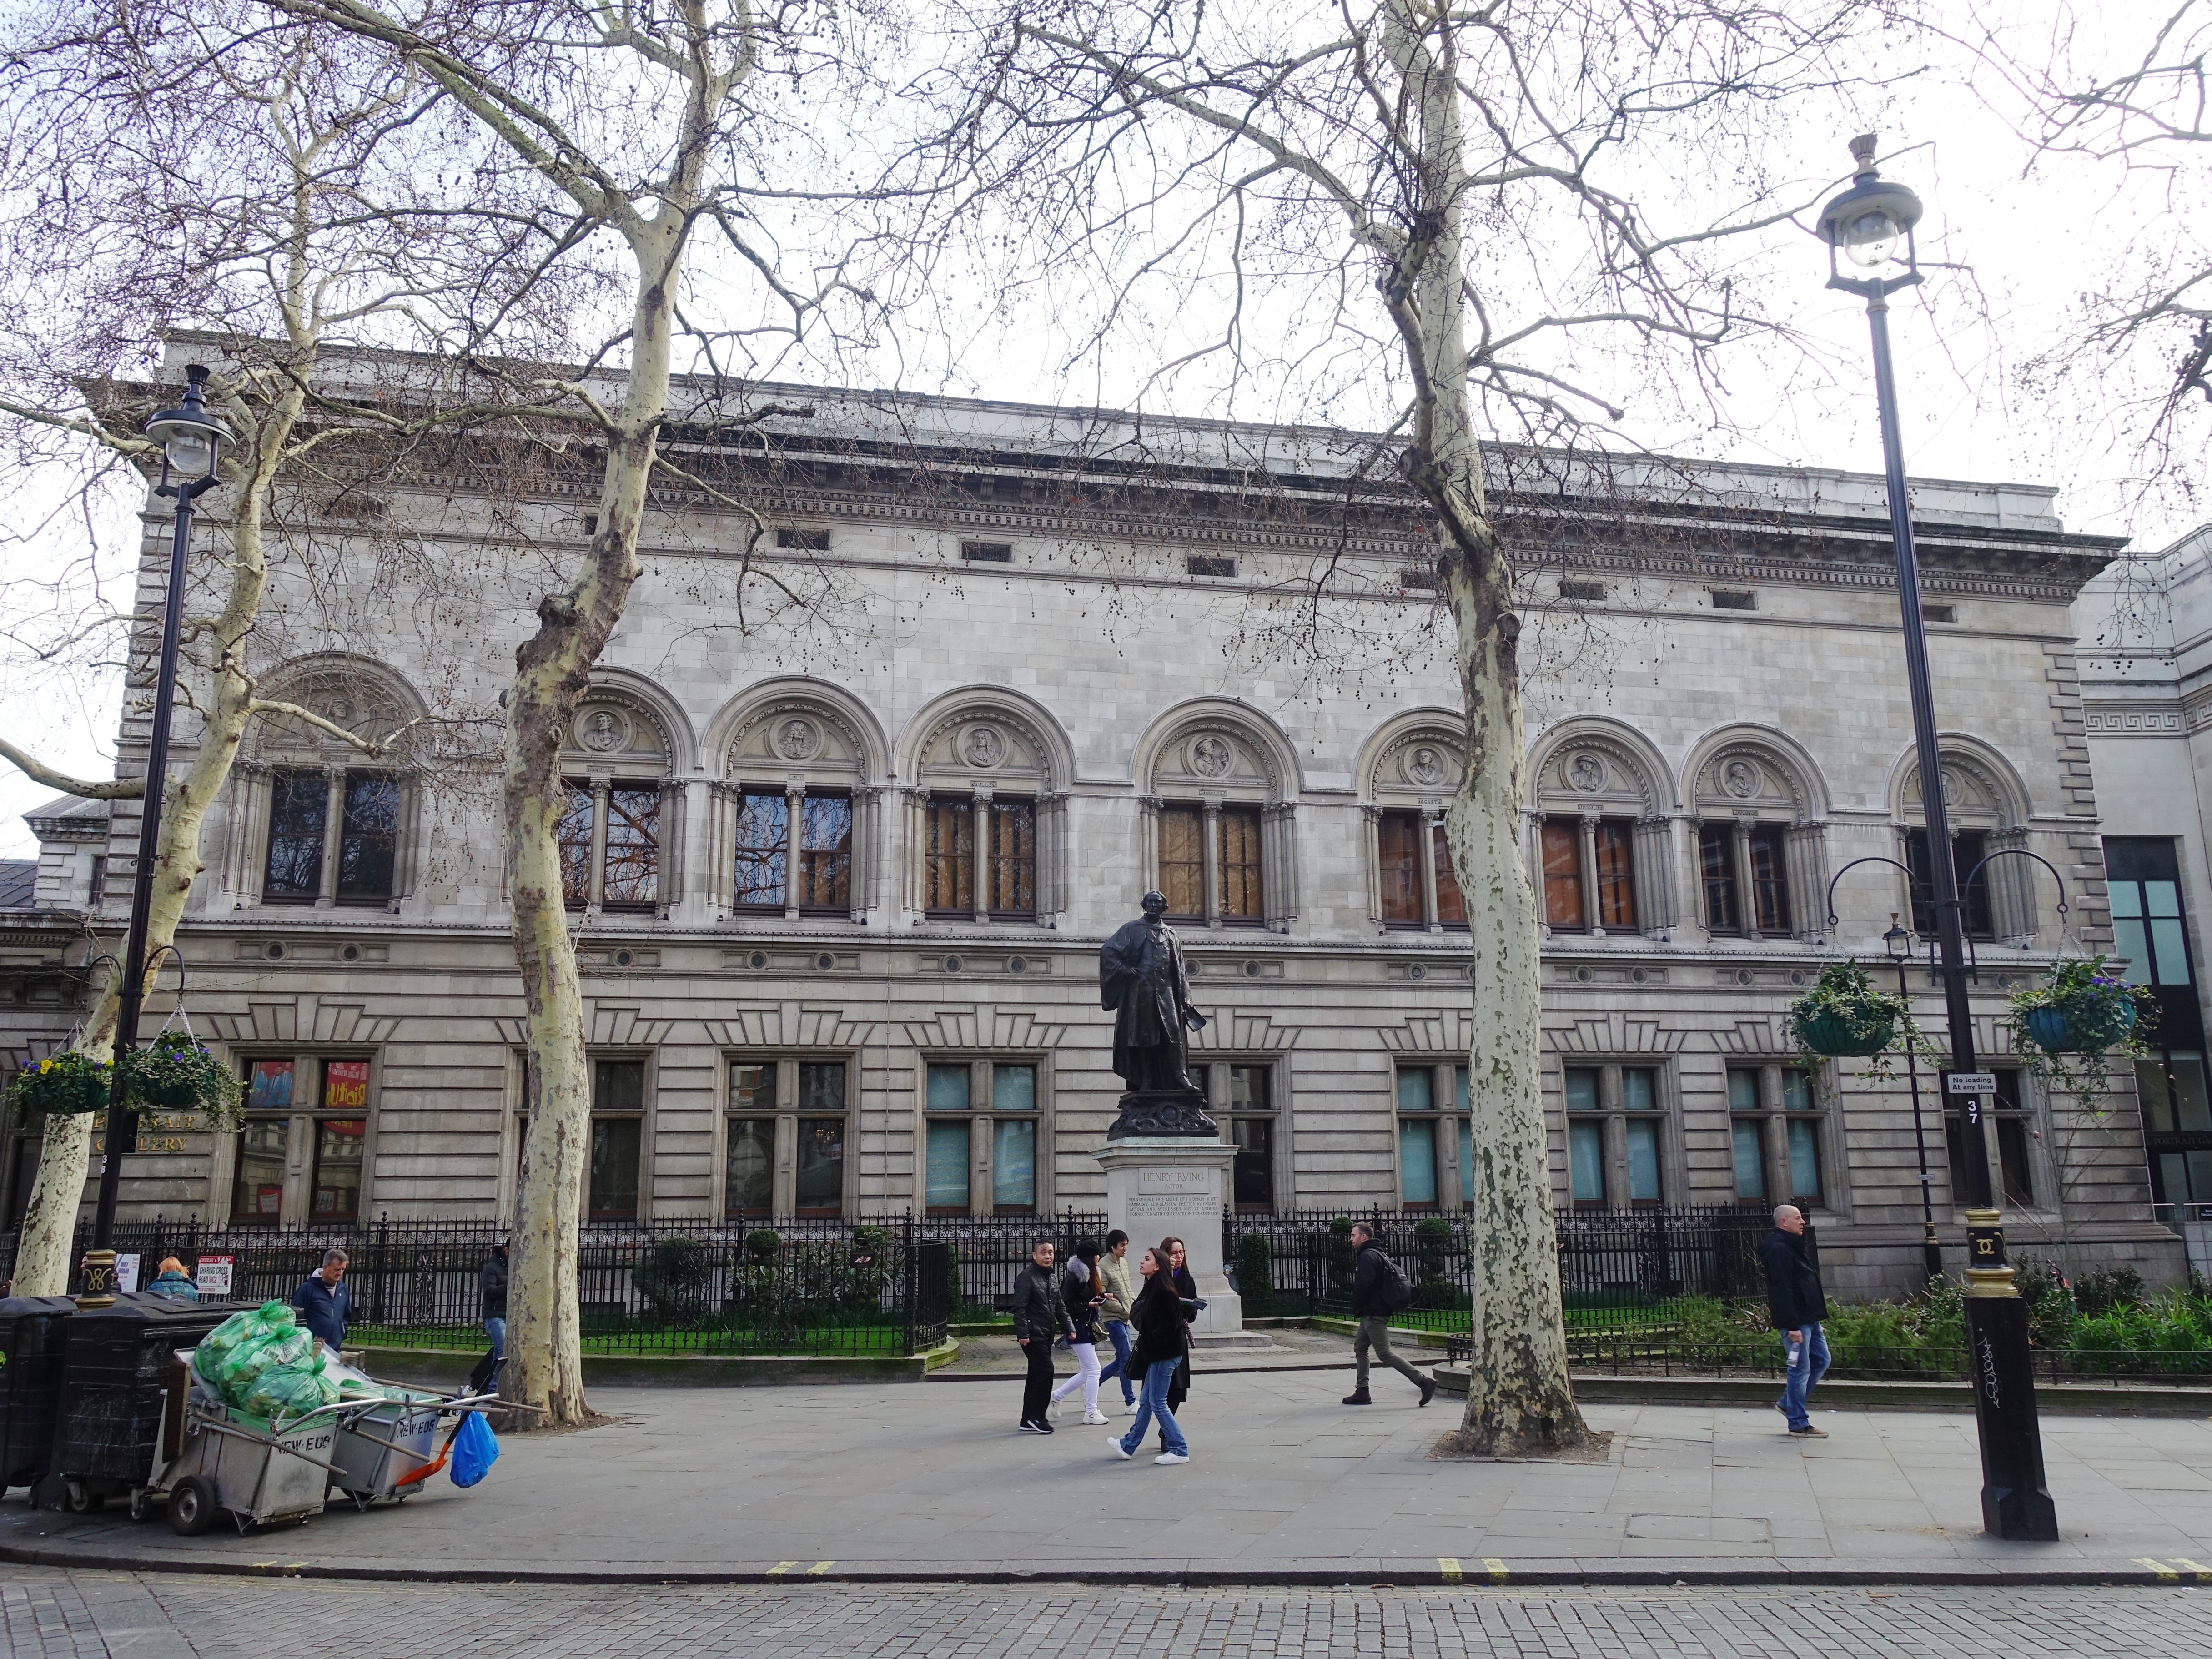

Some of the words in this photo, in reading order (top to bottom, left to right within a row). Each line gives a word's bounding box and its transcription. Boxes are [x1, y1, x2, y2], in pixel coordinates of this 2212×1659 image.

[1143, 1172, 1173, 1181] HENRY
[1175, 1172, 1204, 1181] IRVING
[216, 1267, 228, 1275] CROSS
